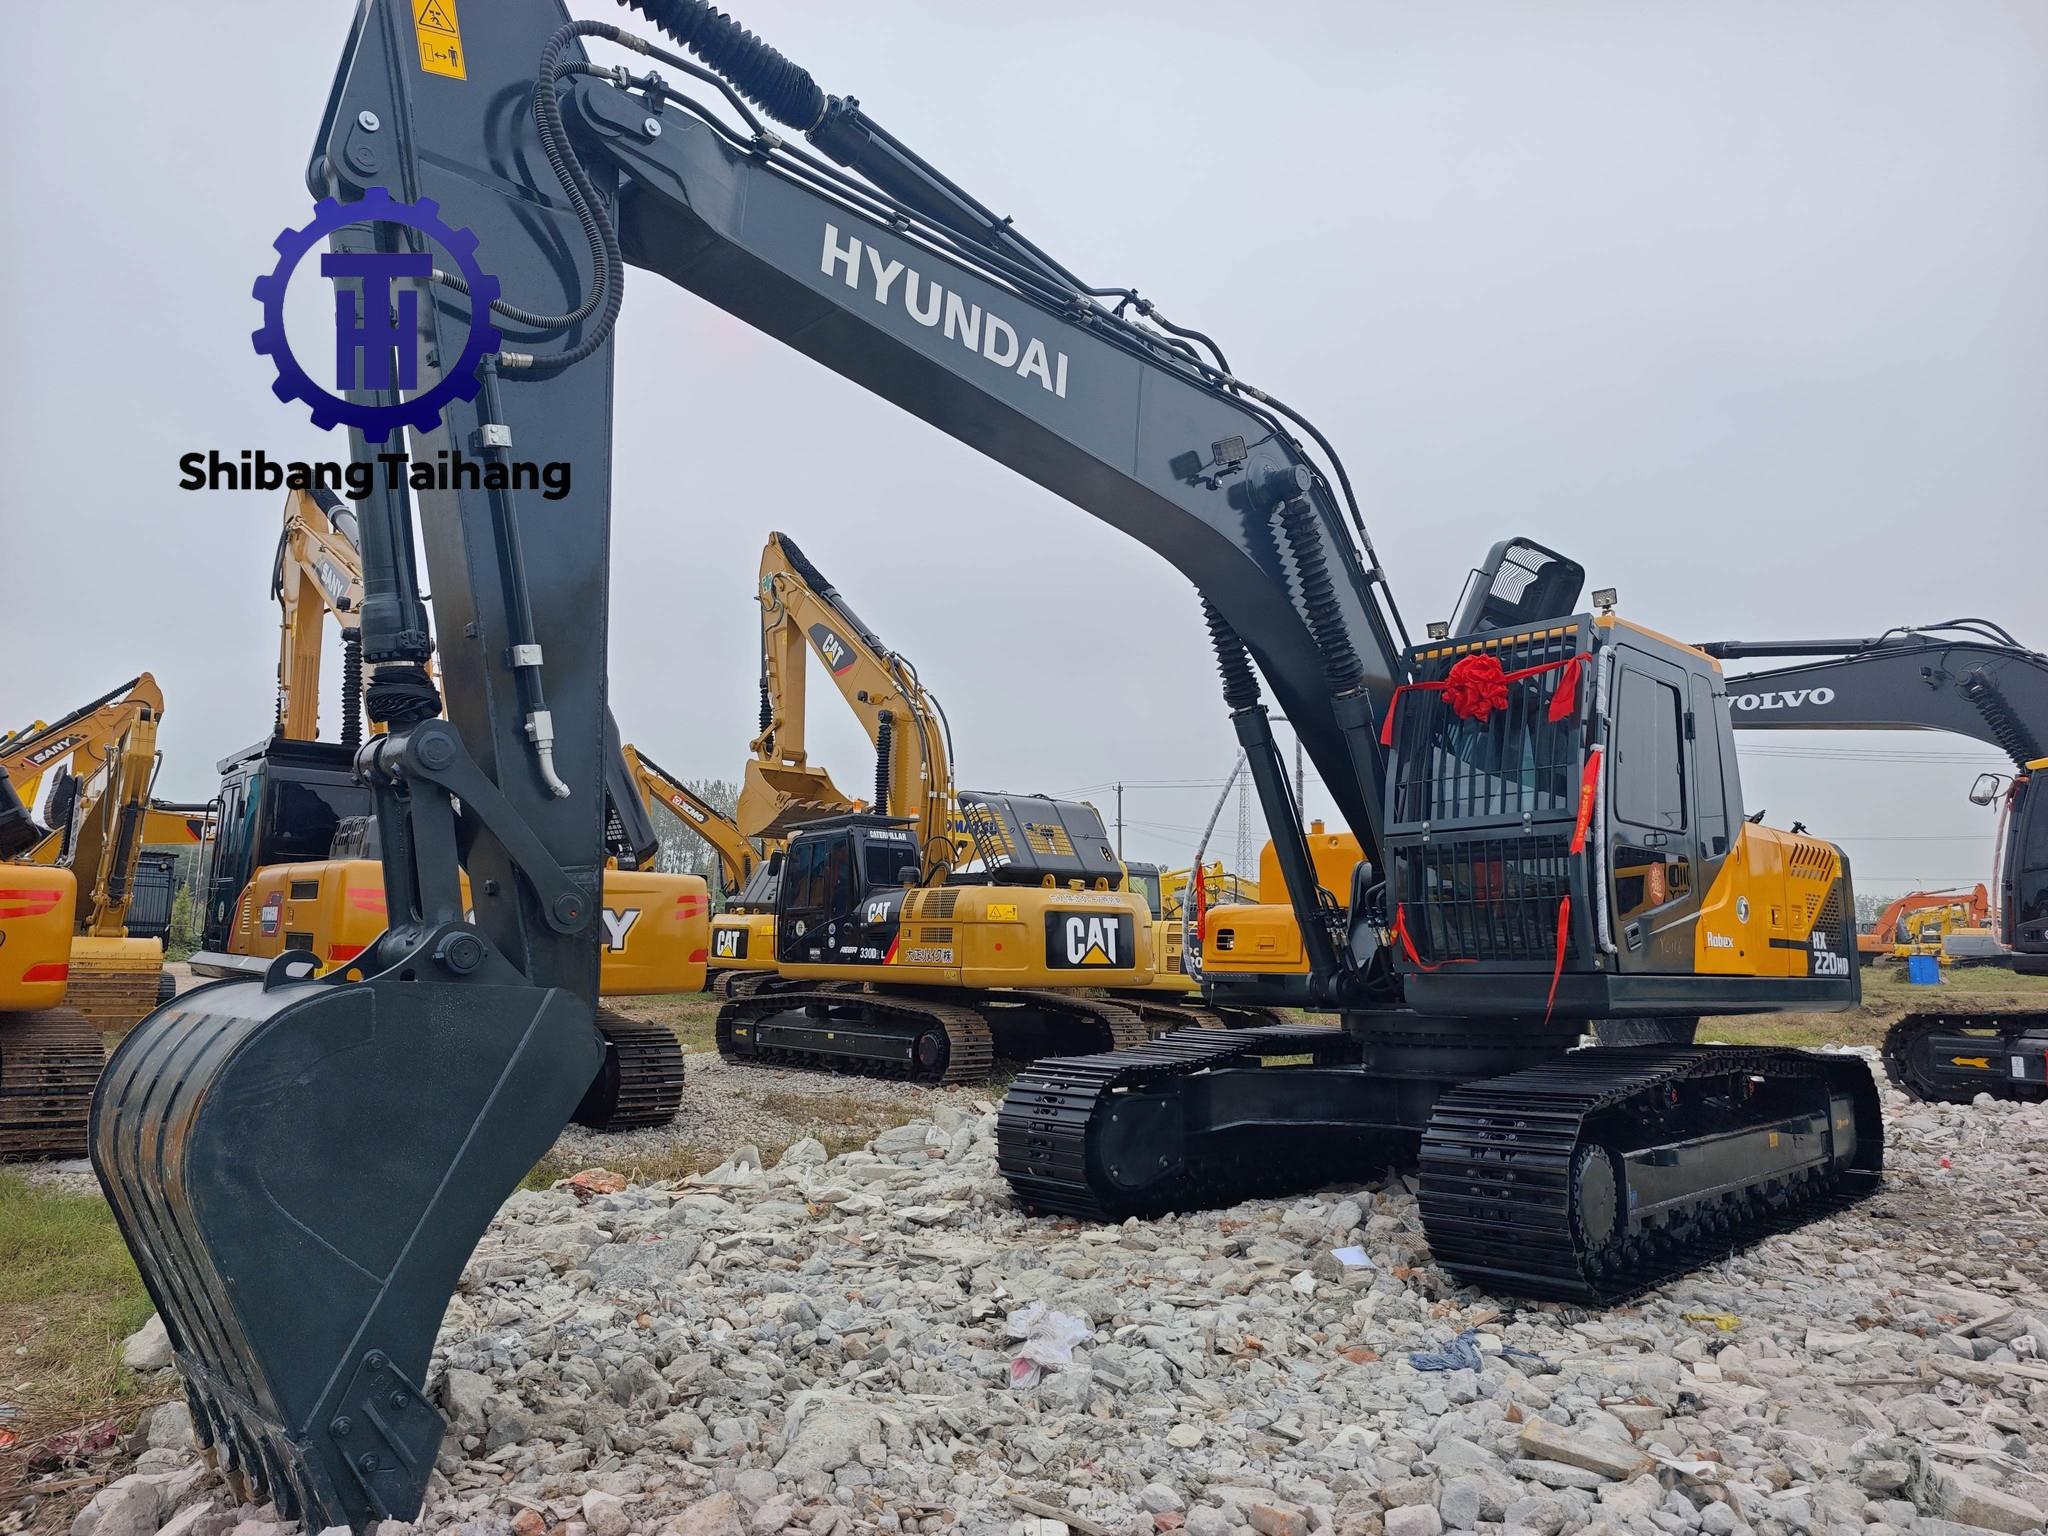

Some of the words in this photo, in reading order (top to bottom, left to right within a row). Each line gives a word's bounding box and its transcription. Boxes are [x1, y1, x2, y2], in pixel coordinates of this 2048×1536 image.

[821, 223, 1068, 399] HYUNDAI
[321, 562, 344, 599] SANY
[822, 633, 845, 667] CAT
[34, 737, 72, 764] SANY
[869, 830, 907, 841] CATERPILLAR
[868, 901, 891, 923] CAT
[717, 930, 740, 957] CAT
[1066, 916, 1119, 965] CAT
[1706, 931, 1734, 948] Robex
[1812, 931, 1827, 950] HX
